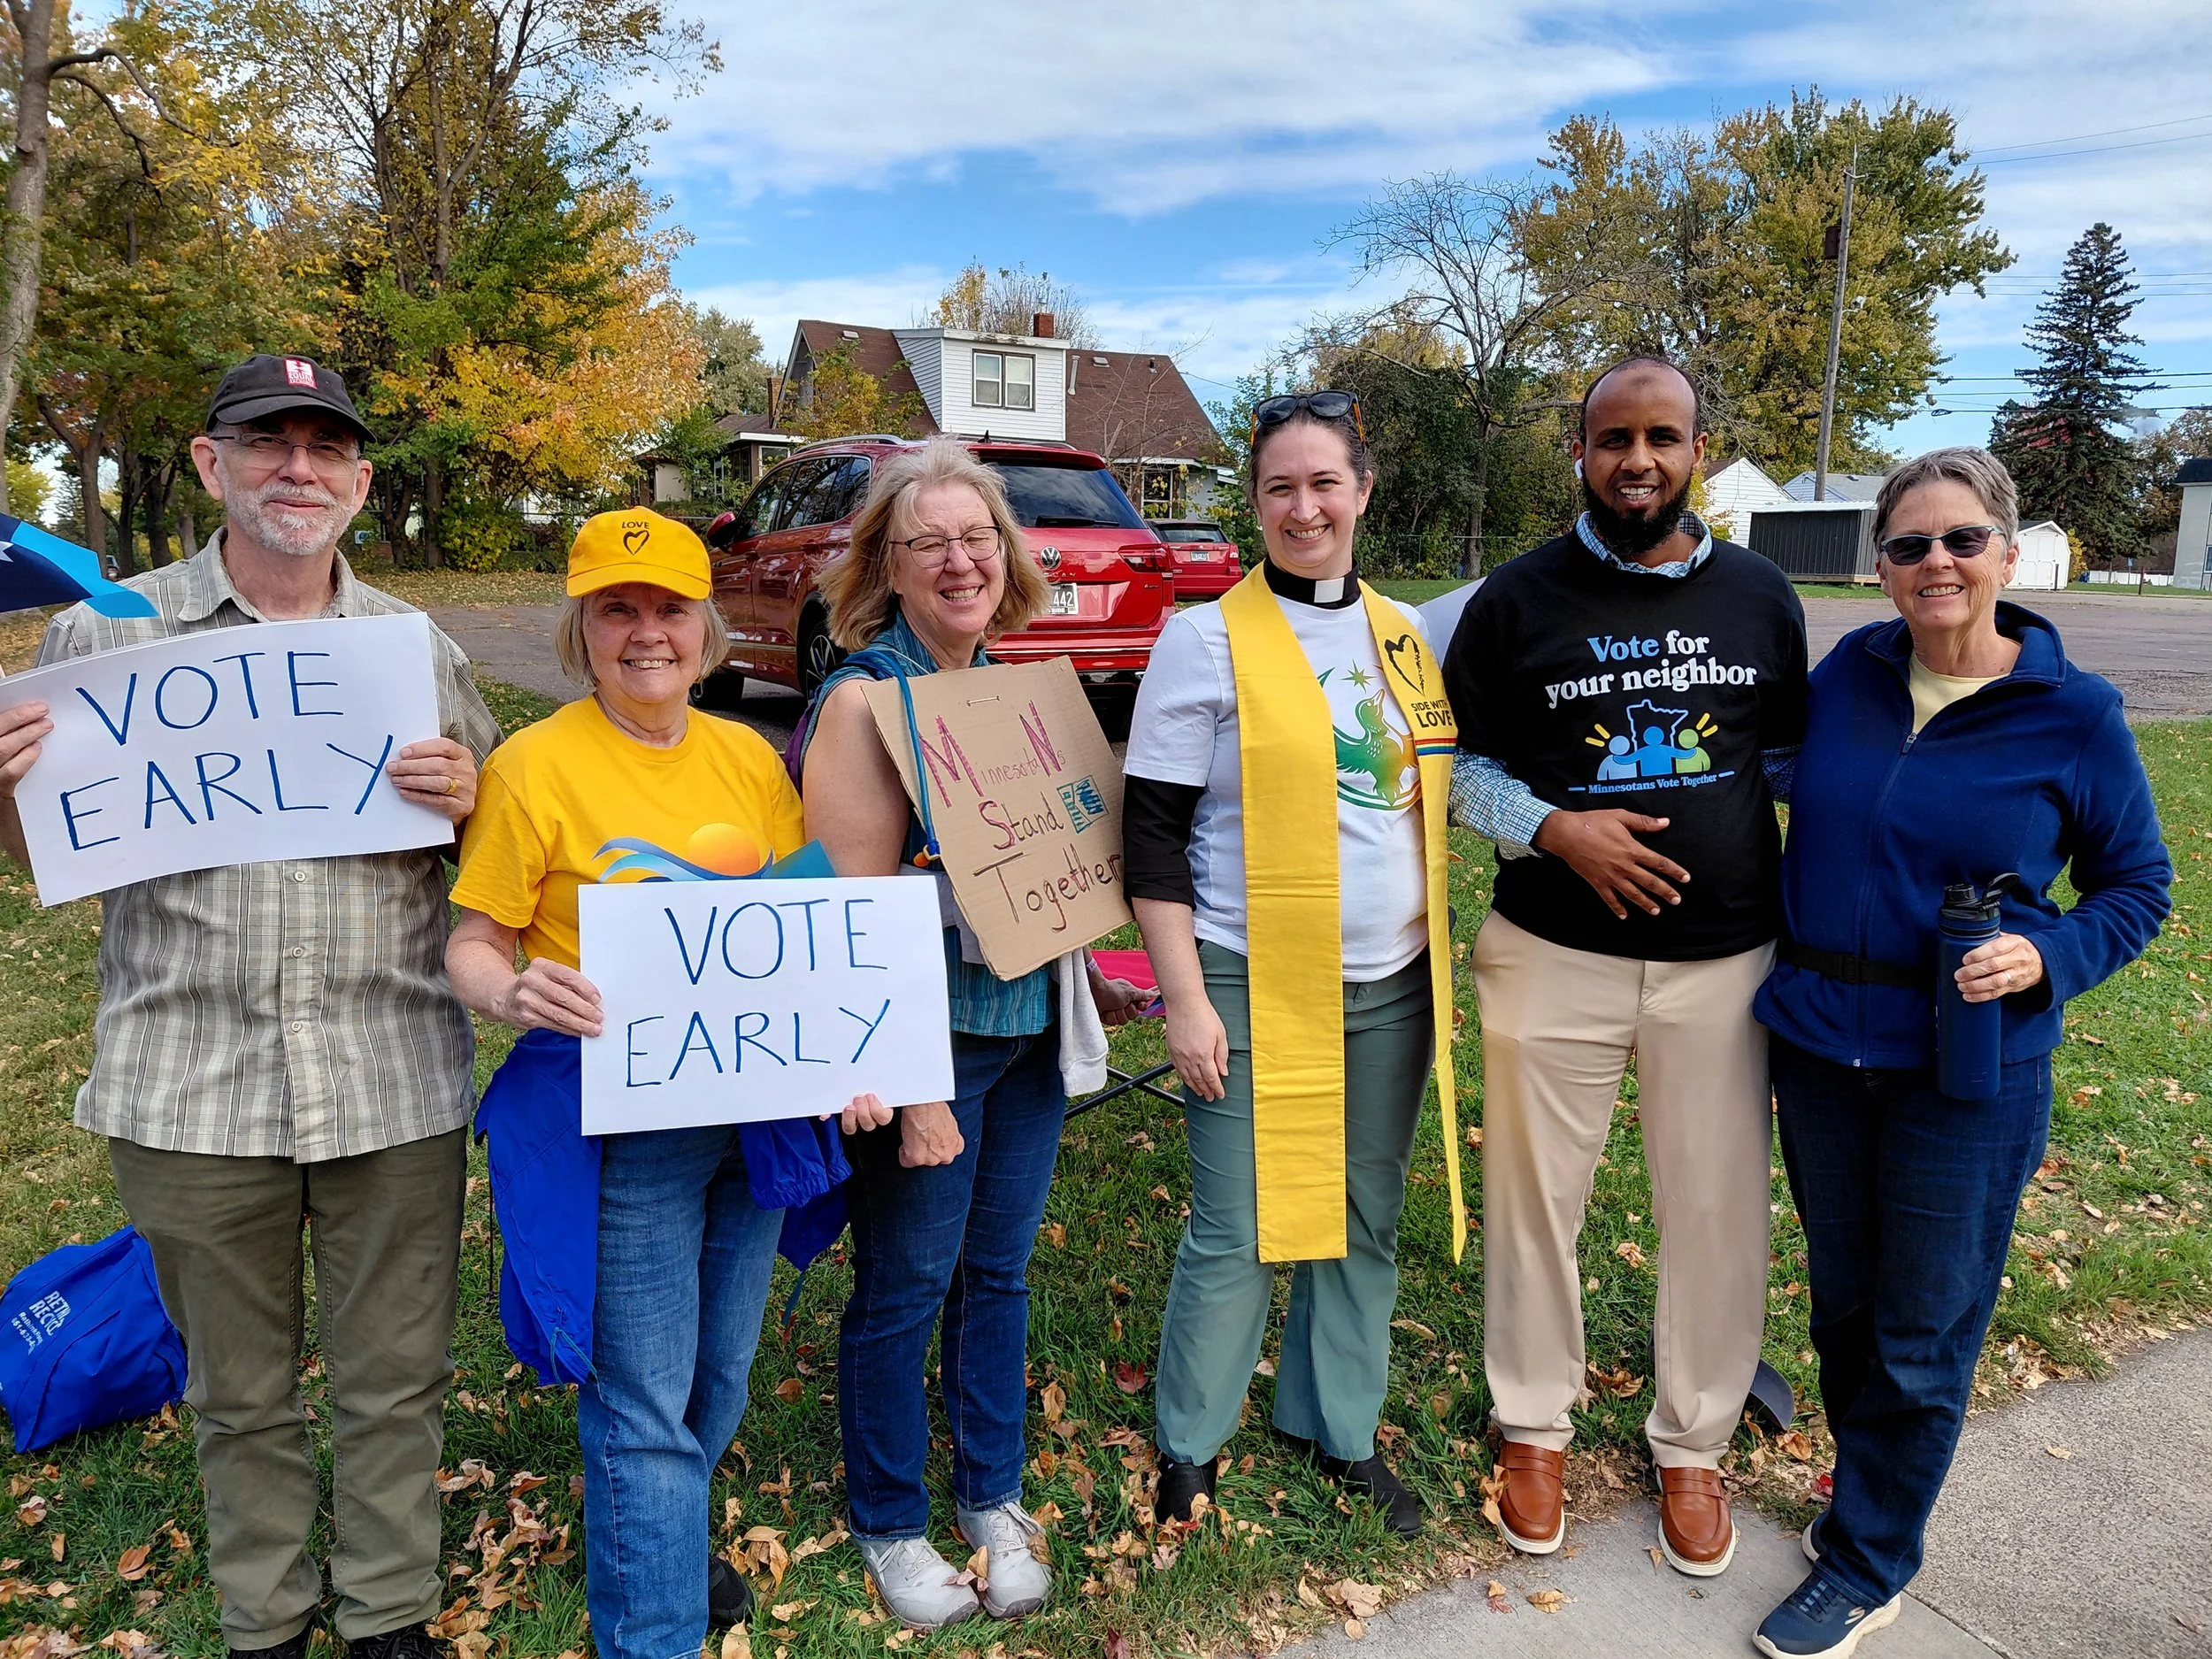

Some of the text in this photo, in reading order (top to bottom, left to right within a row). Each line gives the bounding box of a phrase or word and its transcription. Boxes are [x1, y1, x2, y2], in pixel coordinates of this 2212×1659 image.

[622, 521, 650, 530] LOVE
[1586, 629, 1710, 663] Vote for
[75, 650, 345, 747] VOTE
[1410, 699, 1448, 711] SIDE WITH
[1544, 657, 1757, 710] your neighbor
[1416, 710, 1453, 727] LOVE
[58, 733, 395, 852] EARLY
[1587, 772, 1717, 795] Minnesotans Vote Together
[978, 792, 1064, 850] Stand
[972, 842, 1122, 933] Together
[664, 897, 888, 986] VOTE
[626, 998, 891, 1088] EARLY
